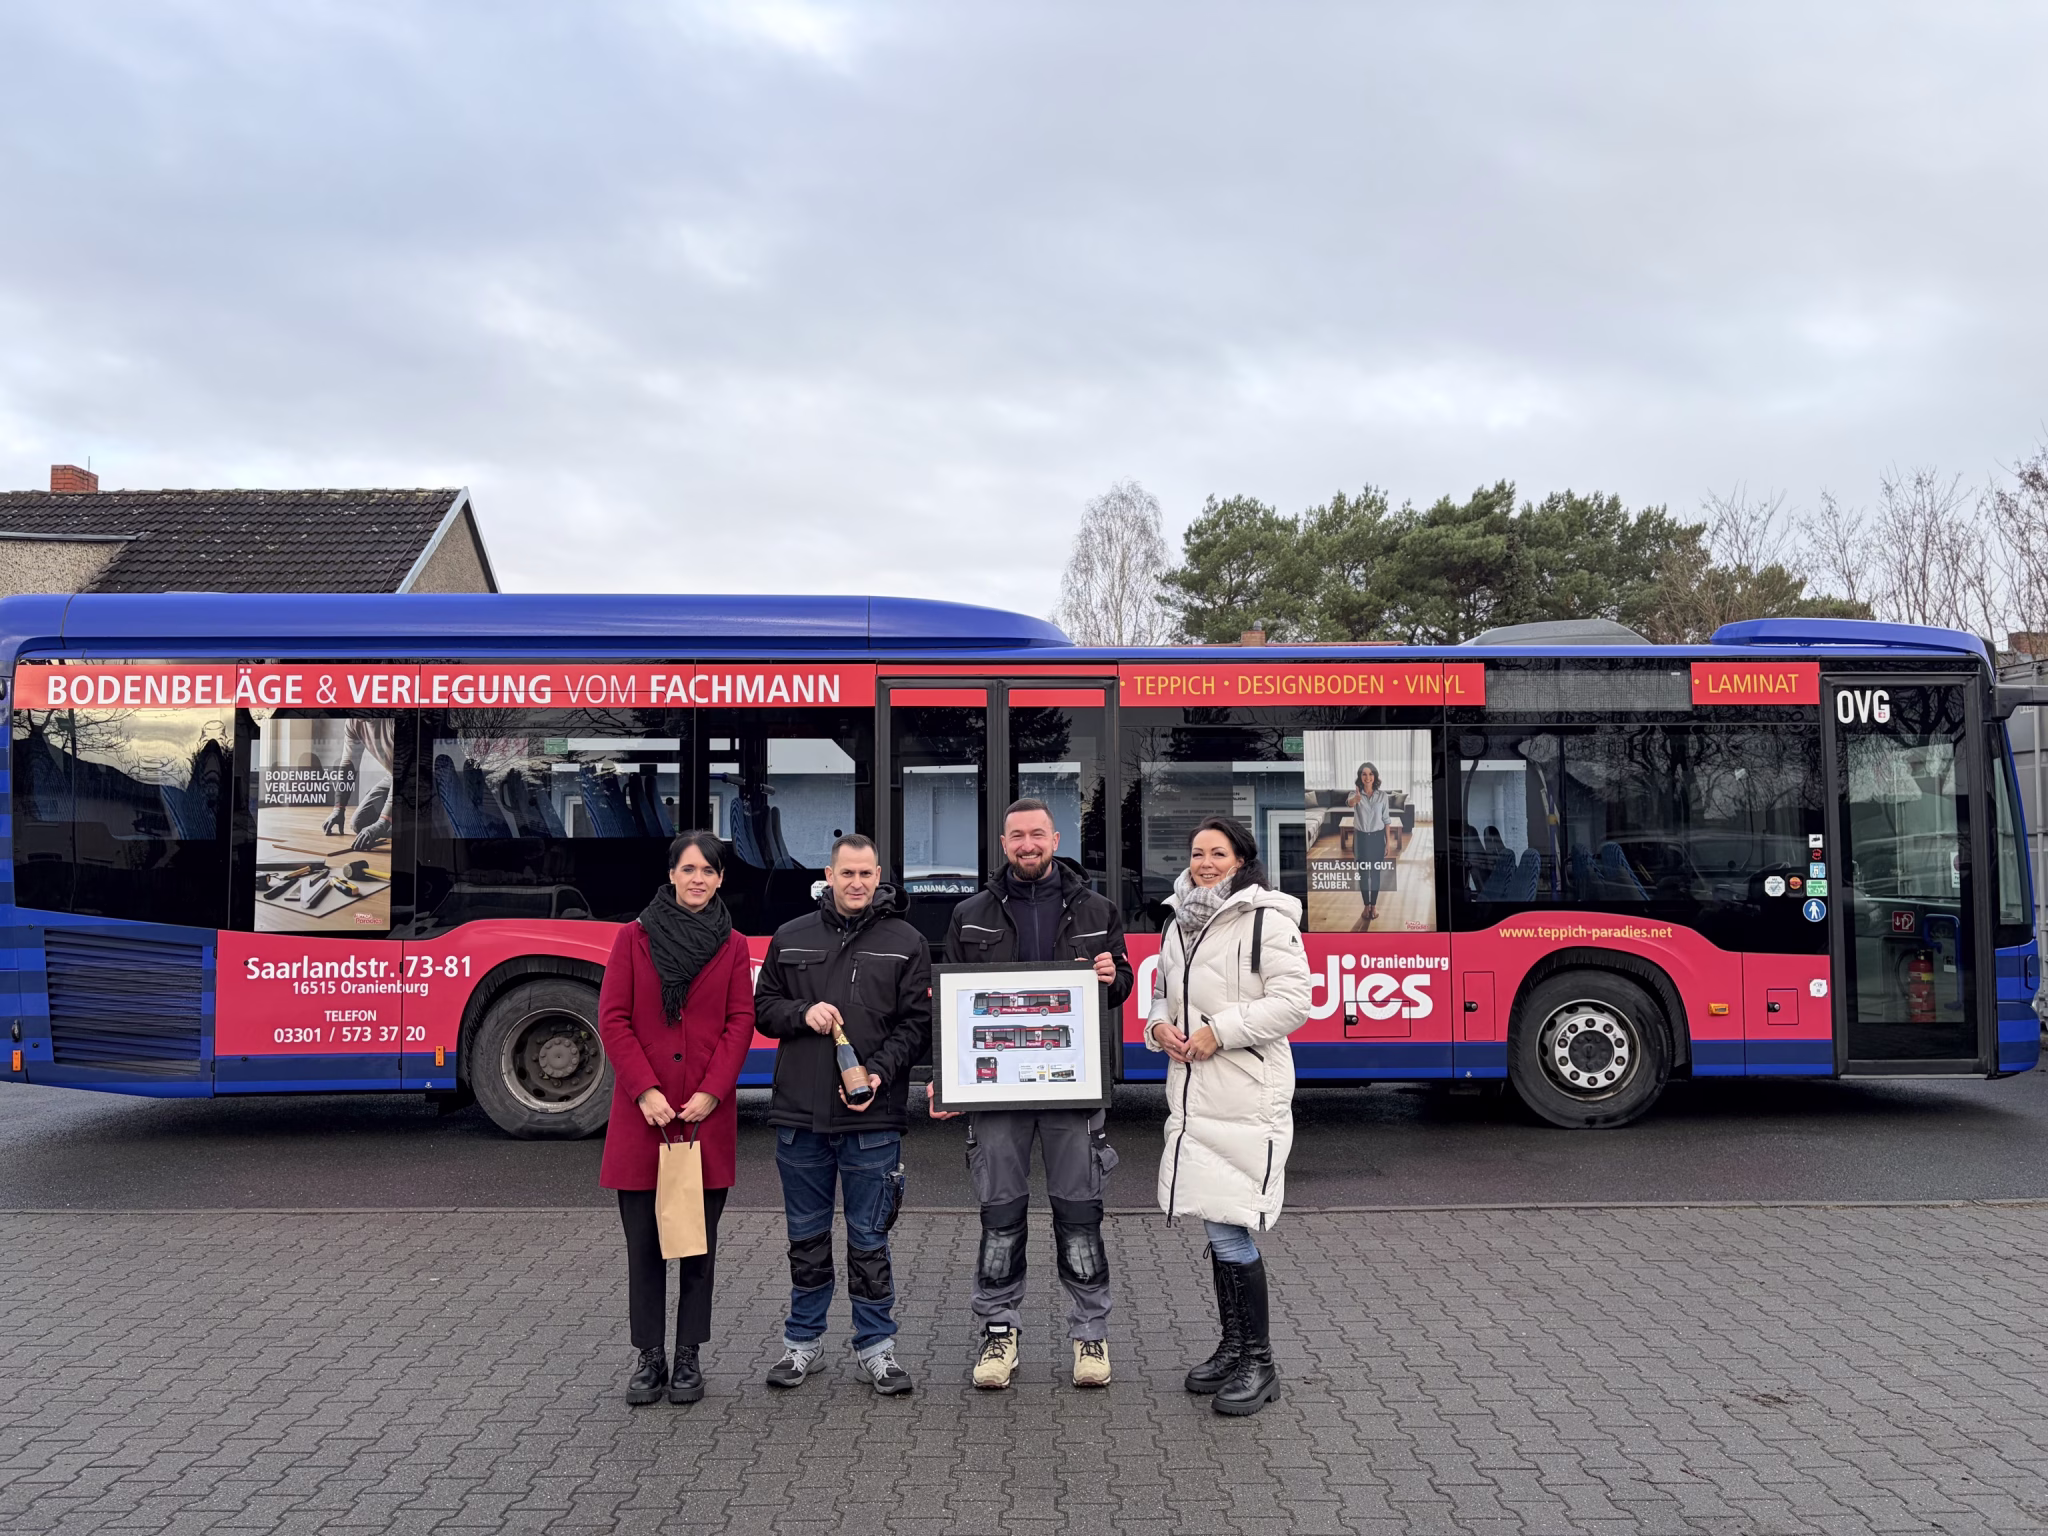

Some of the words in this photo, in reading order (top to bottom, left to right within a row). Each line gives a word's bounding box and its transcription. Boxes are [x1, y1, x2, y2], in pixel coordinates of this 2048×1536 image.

[47, 668, 303, 705] BODENBELÄGE
[316, 674, 338, 704] &
[347, 674, 552, 705] VERLEGUNG
[564, 674, 637, 704] VOM
[650, 674, 841, 704] FACHMANN
[1133, 676, 1216, 696] TEPPICH
[1237, 675, 1385, 695] DESIGNBODEN
[1404, 674, 1466, 695] VINYL
[1707, 673, 1800, 694] LAMINAT
[1836, 689, 1891, 724] OVG
[265, 768, 344, 781] BODENBELÄGE
[346, 770, 355, 781] &
[264, 781, 330, 792] VERLEGUNG
[331, 781, 356, 792] VOM
[264, 793, 327, 804] FACHMANN
[1311, 860, 1372, 871] VERLÄSSLICH
[1374, 861, 1395, 870] GUT.
[1312, 872, 1352, 881] SCHNELL
[1354, 872, 1361, 881] &
[1312, 881, 1351, 890] SAUBER.
[912, 884, 947, 893] BANANA
[1499, 925, 1673, 943] www.teppich-paradies.net
[246, 955, 396, 980] Saarlandstr.
[404, 955, 471, 978] 73-81
[1360, 953, 1450, 971] Oranienburg
[292, 981, 336, 995] 16515
[340, 979, 429, 997] Oranienburg
[324, 1009, 377, 1022] TELEFON
[273, 1027, 321, 1043] 03301
[328, 1027, 336, 1042] /
[342, 1027, 372, 1042] 573
[378, 1025, 399, 1042] 37
[405, 1025, 426, 1041] 20
